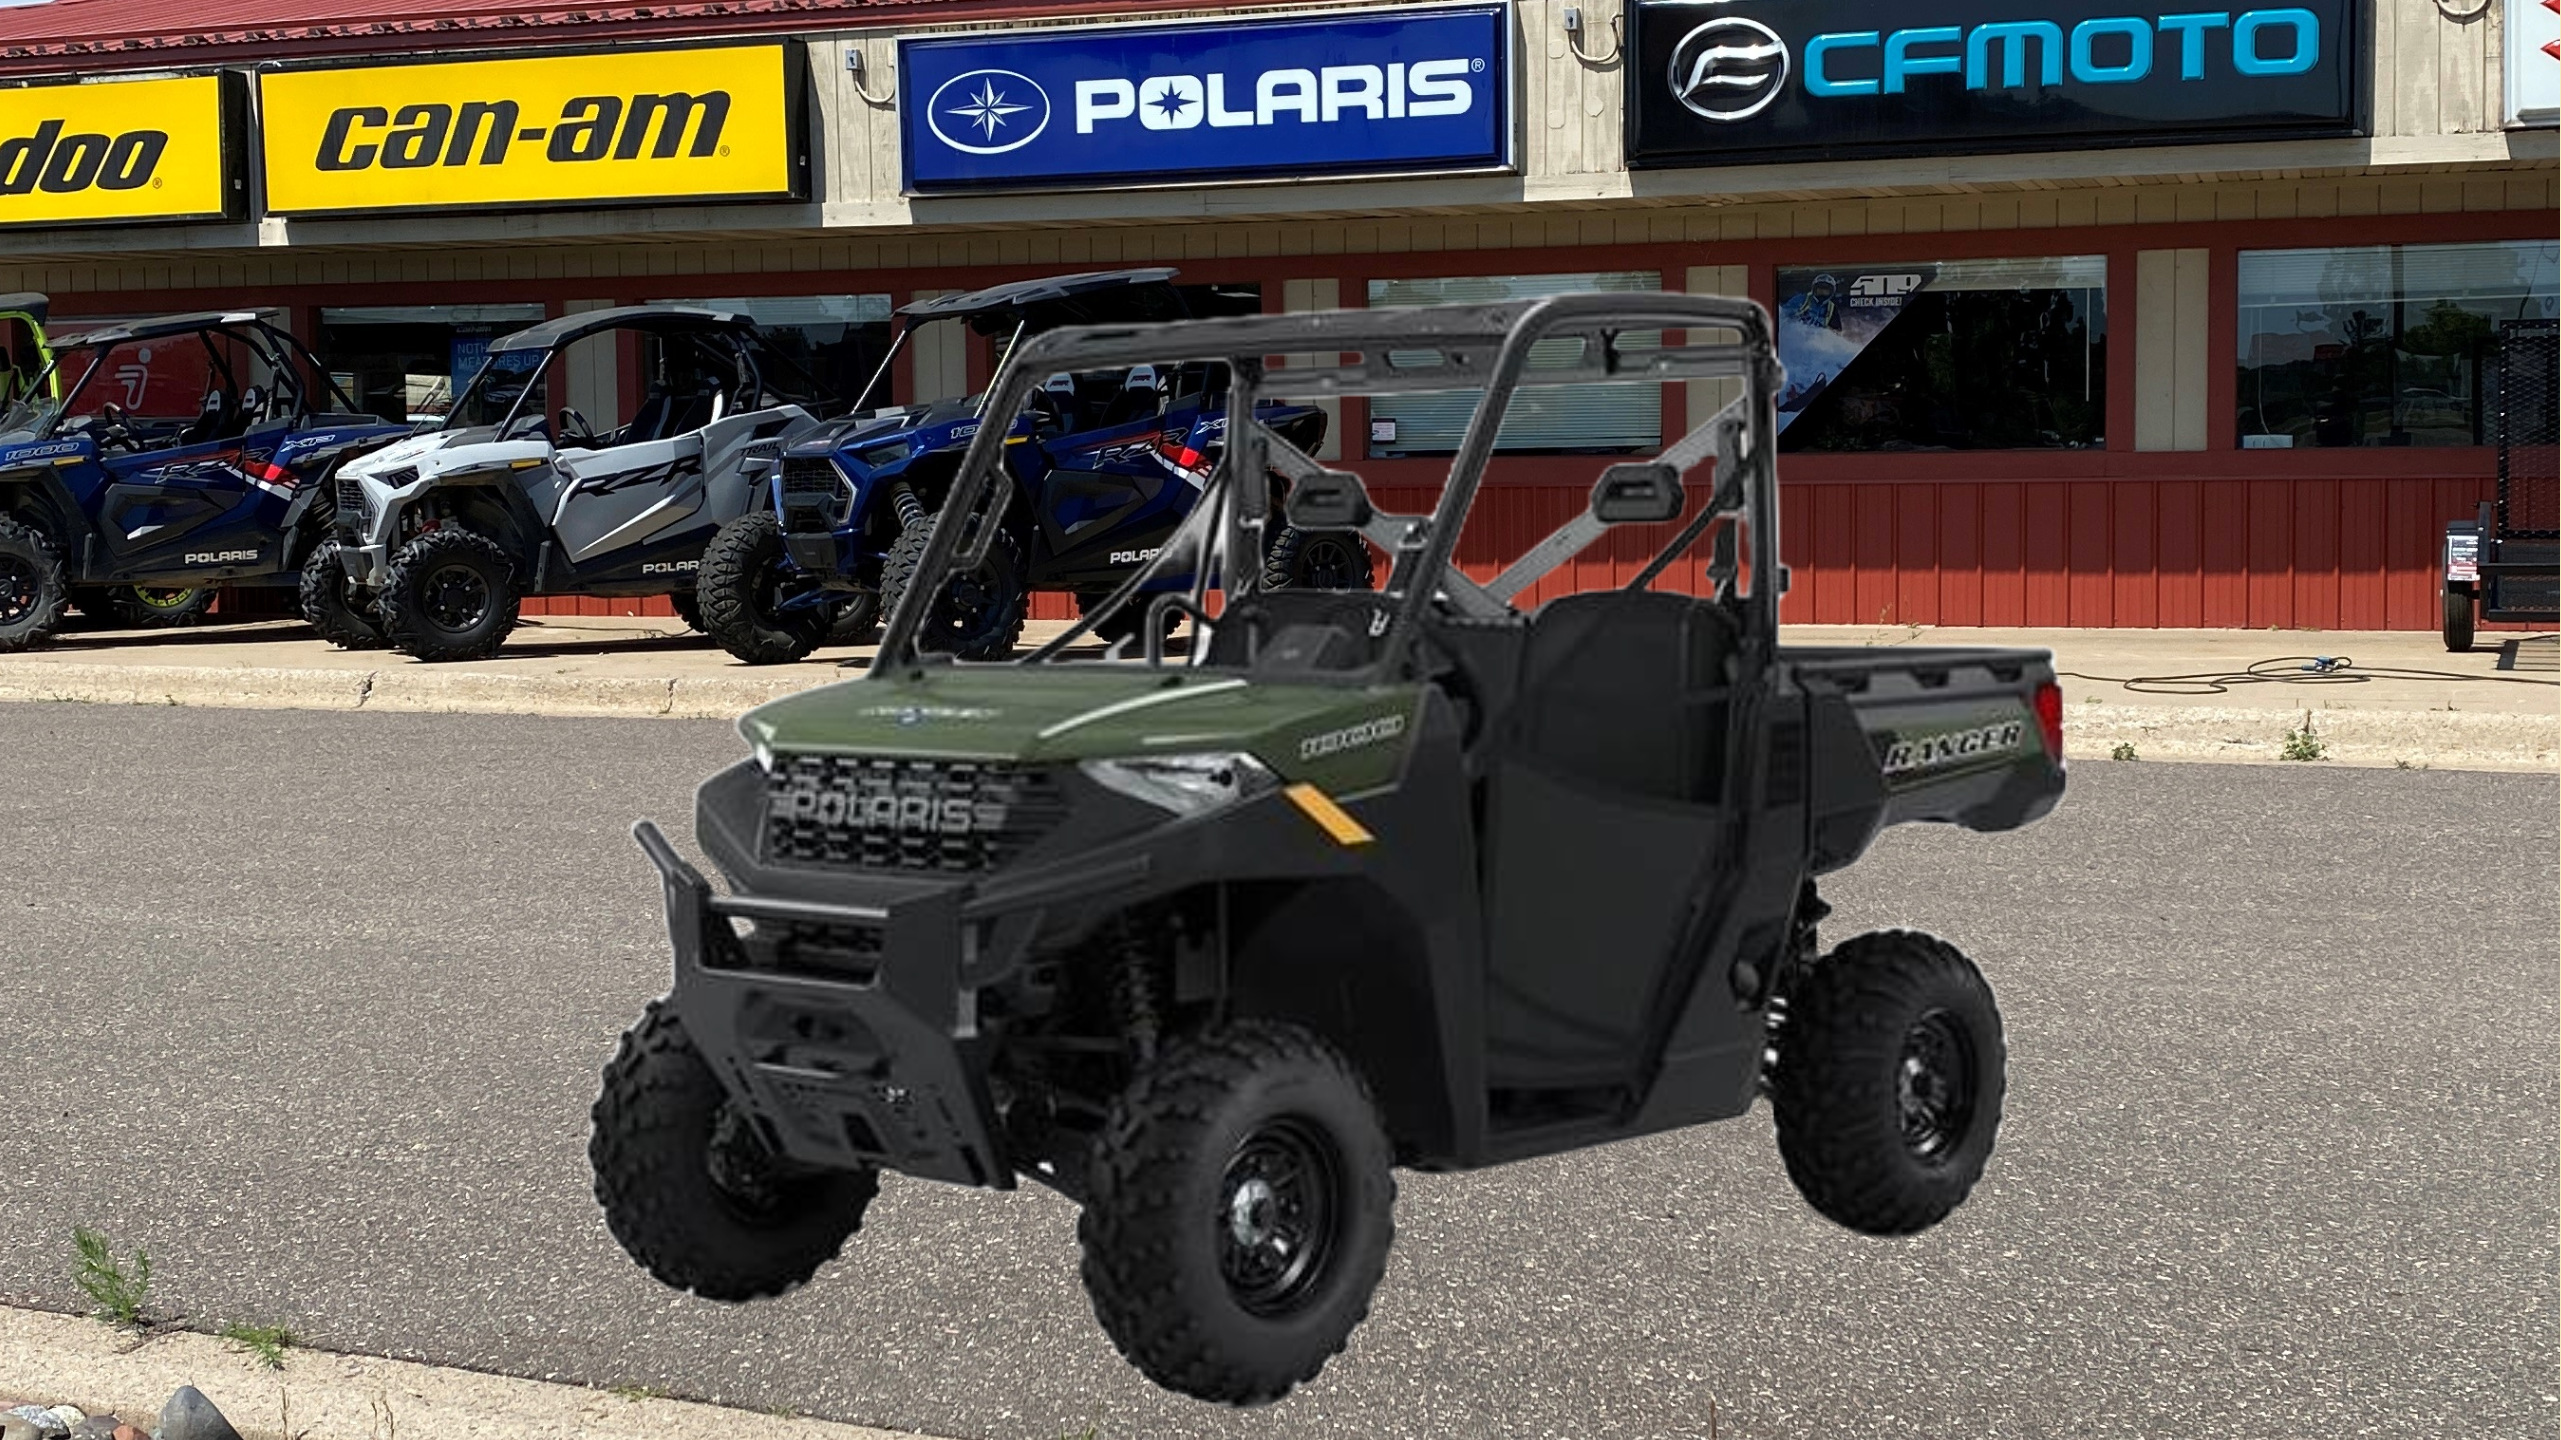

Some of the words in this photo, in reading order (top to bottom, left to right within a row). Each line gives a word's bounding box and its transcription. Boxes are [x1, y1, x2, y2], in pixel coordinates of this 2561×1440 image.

[1804, 7, 2319, 98] CFMOTO
[1075, 58, 1473, 134] POLARIS
[315, 90, 731, 171] can-am
[1849, 274, 1922, 296] 509
[1850, 296, 1874, 308] CHECK
[457, 342, 489, 355] NOTH
[457, 355, 522, 370] MEASRES
[523, 354, 540, 367] UP
[5, 442, 80, 461] 1000
[740, 441, 779, 456] TRAIL
[1092, 427, 1189, 470] RZR
[567, 452, 702, 503] RZR
[184, 549, 258, 564] POLARIS
[1109, 547, 1163, 565] POLAR
[642, 560, 700, 574] POLAR
[1883, 720, 2021, 776] RANGER
[791, 790, 972, 834] POLARIS
